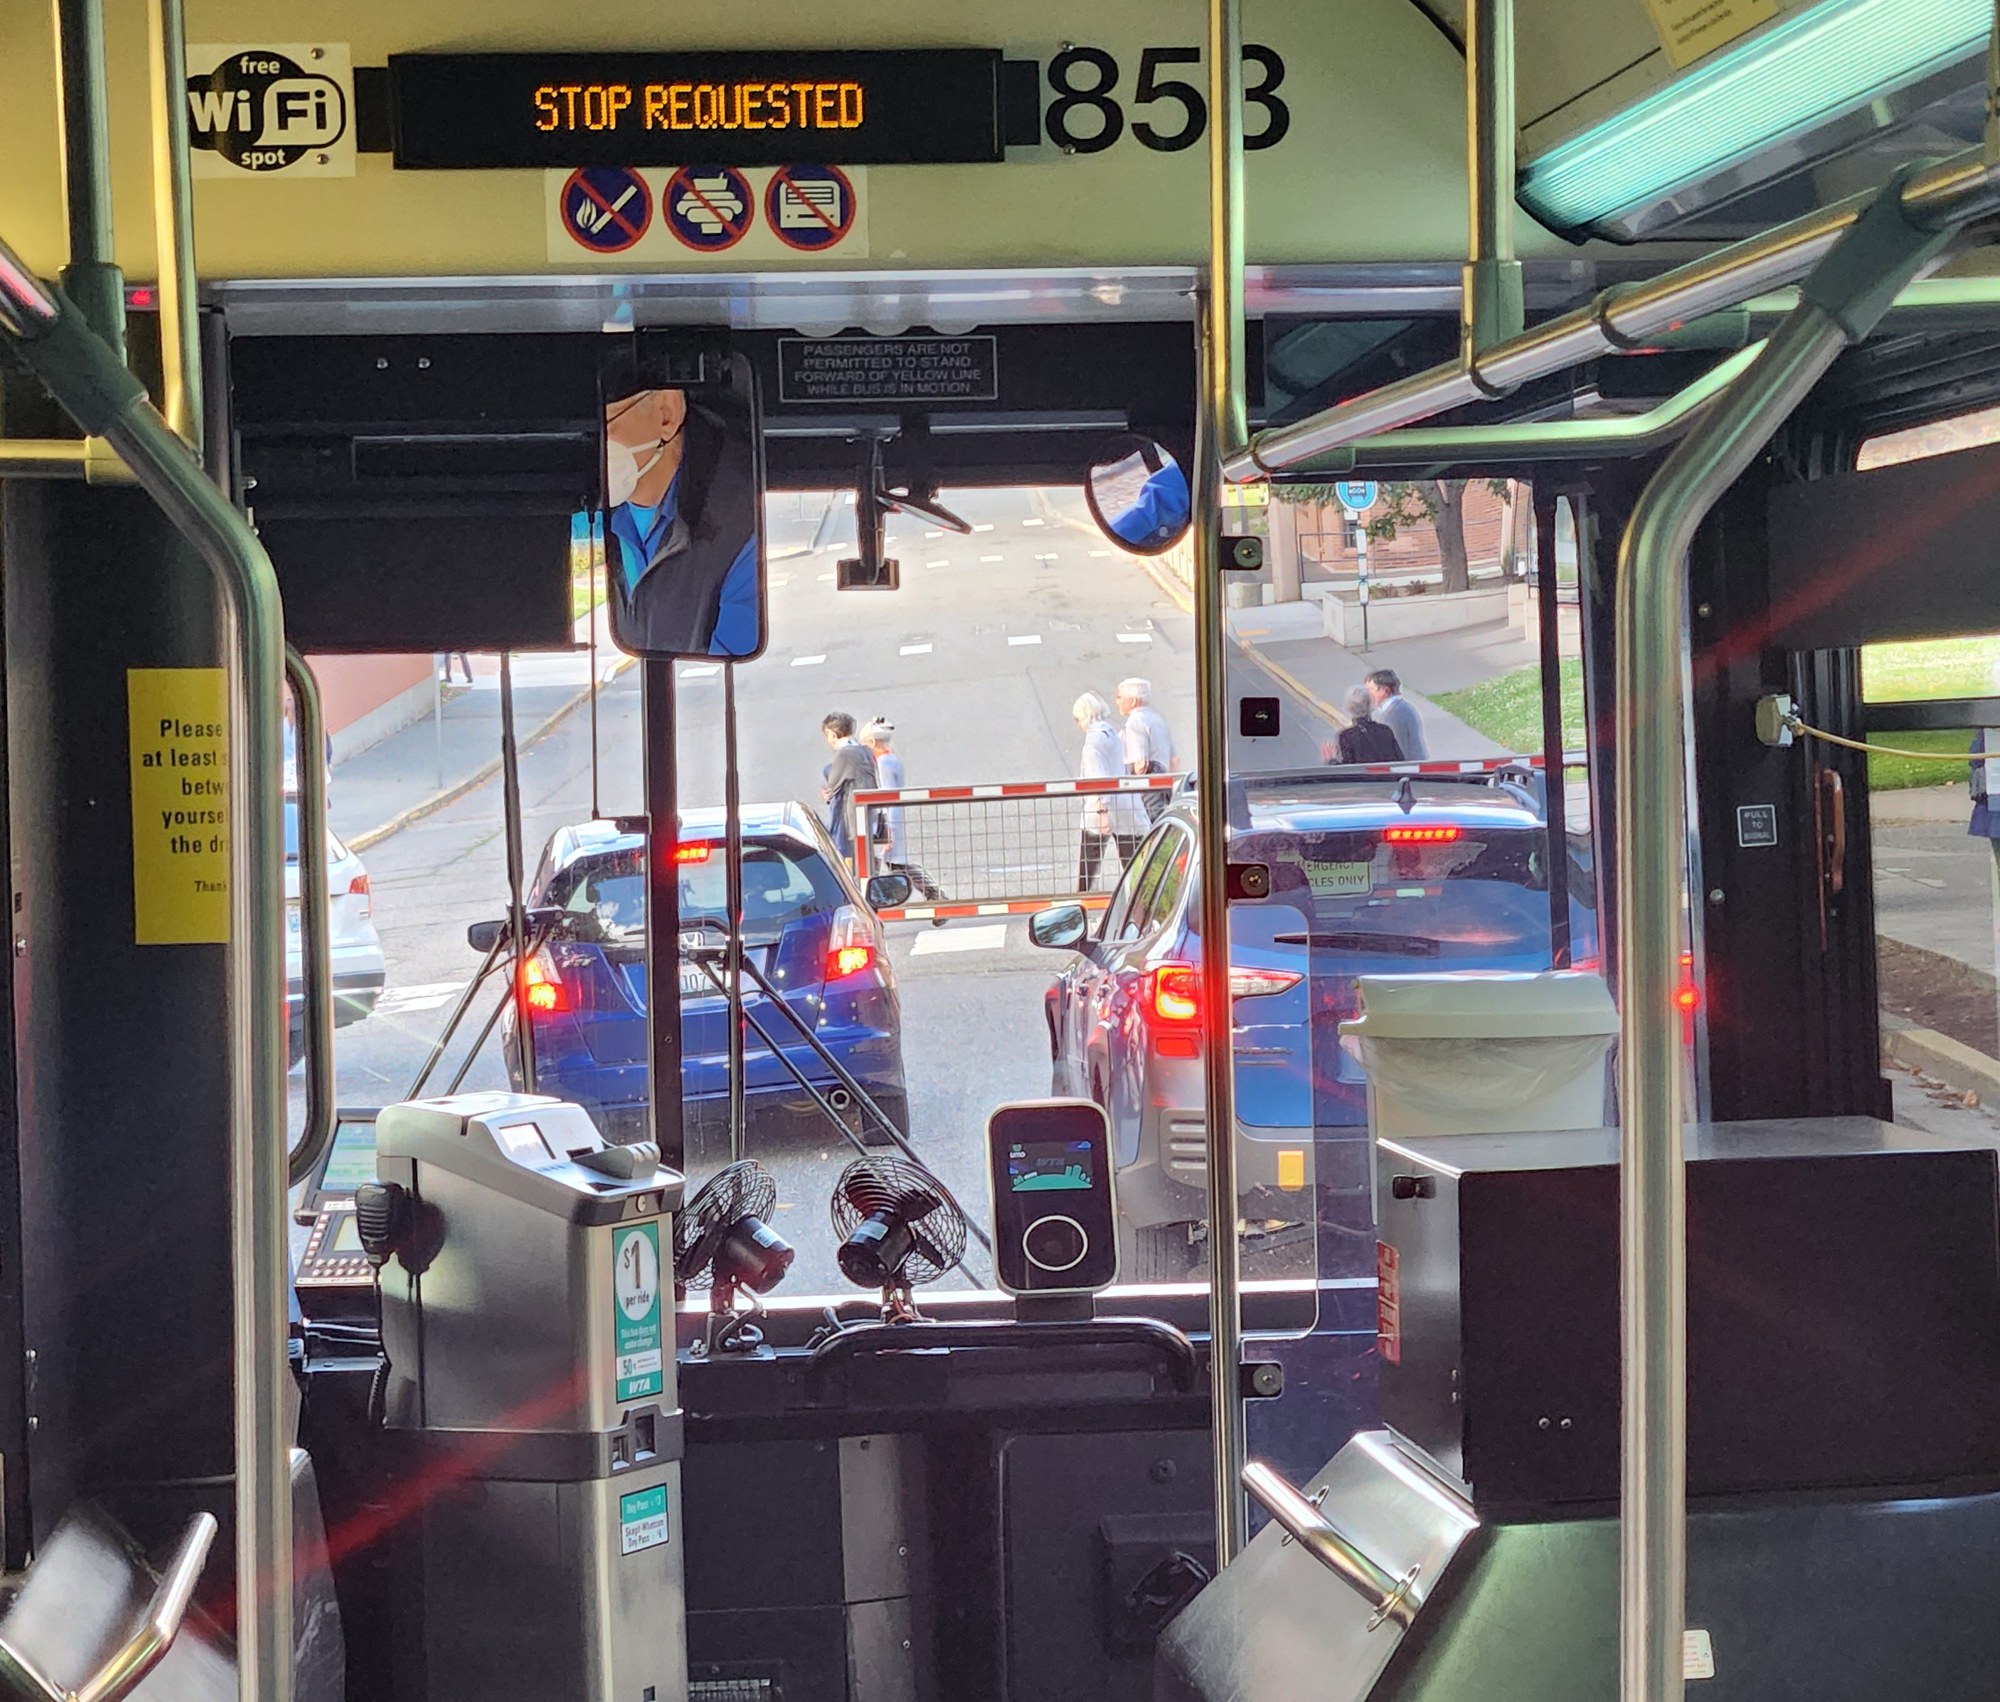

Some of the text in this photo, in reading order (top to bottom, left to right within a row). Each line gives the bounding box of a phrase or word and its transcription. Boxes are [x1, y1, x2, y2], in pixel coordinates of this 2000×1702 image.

[239, 55, 281, 75] free
[534, 83, 864, 131] STOP REQUESTED
[1045, 44, 1291, 154] 853
[240, 149, 286, 170] spot
[802, 342, 972, 356] PASSENGERS ARE NOT
[803, 355, 972, 369] PERMITTED TO STAND
[794, 368, 982, 382] FORWARD OF YELLOW LINE
[806, 381, 971, 396] WHILE BUS IS IN MOTION
[160, 718, 223, 738] Please
[142, 750, 163, 768] at
[170, 748, 217, 768] least
[182, 777, 226, 796] betw
[161, 810, 226, 829] yourse
[1752, 820, 1763, 829] TO
[171, 834, 203, 854] the
[1338, 875, 1365, 887] ONLY
[623, 1239, 642, 1290] $1
[625, 1292, 650, 1311] per ride
[628, 1377, 651, 1395] WTA
